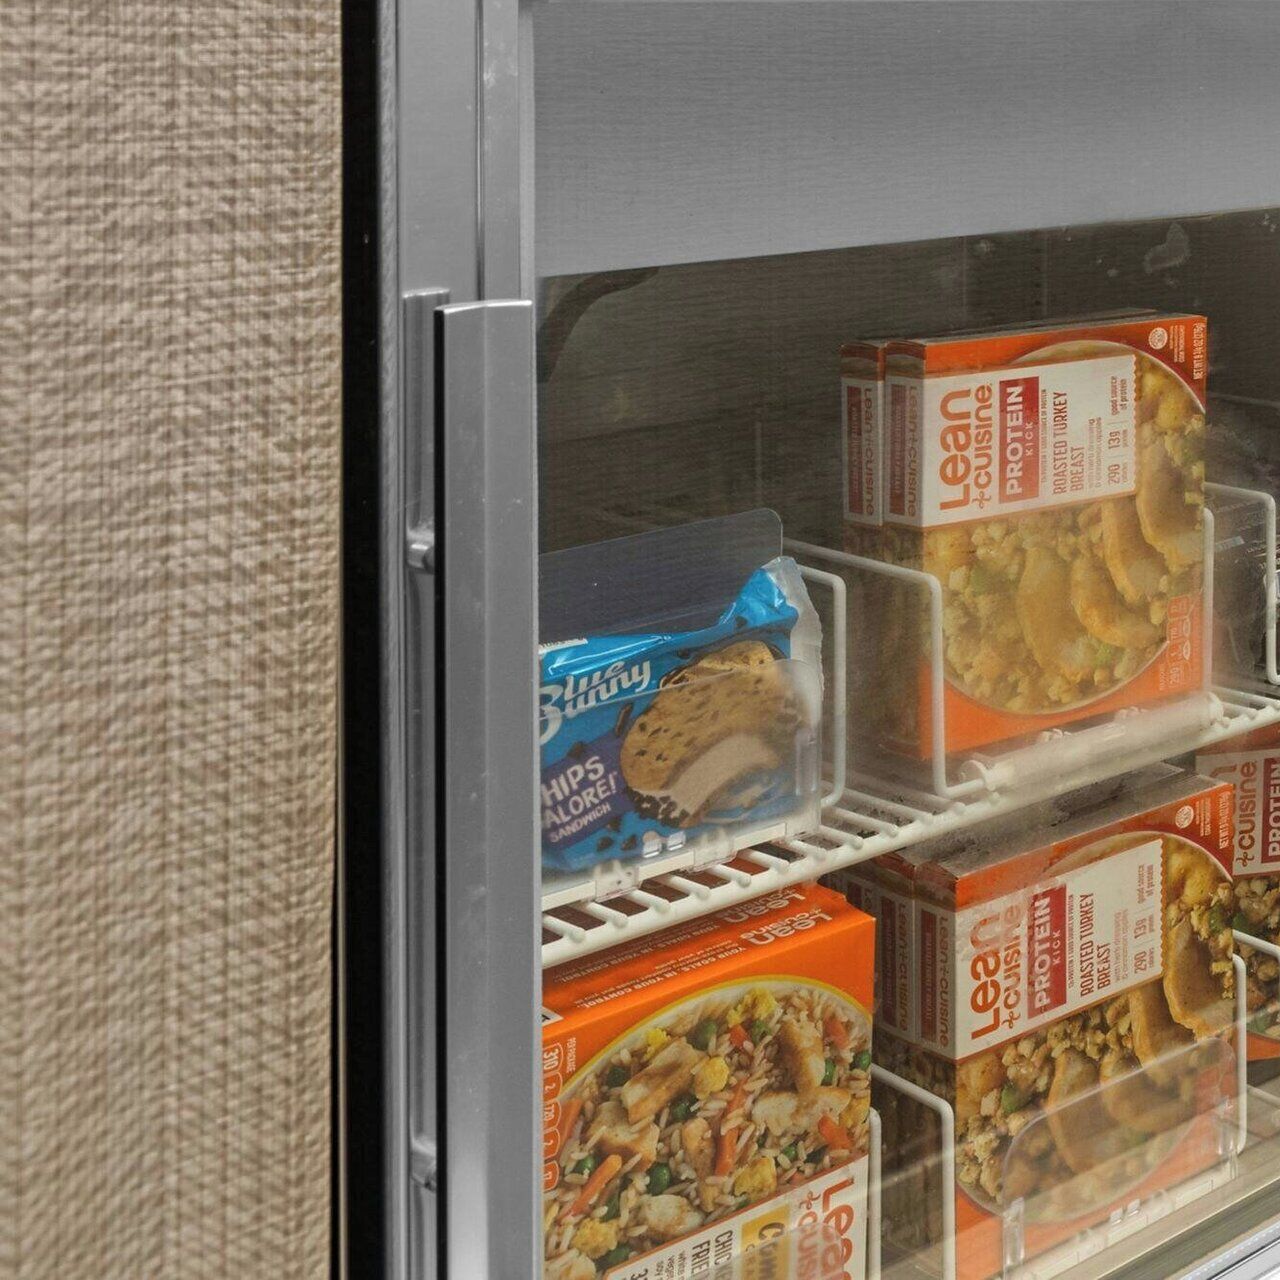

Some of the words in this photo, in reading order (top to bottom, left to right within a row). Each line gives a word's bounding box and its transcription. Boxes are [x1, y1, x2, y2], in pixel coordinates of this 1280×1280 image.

[973, 382, 993, 490] cuisine
[1054, 391, 1068, 438] TURKEY
[940, 388, 972, 511] Lean
[1006, 385, 1024, 496] PROTEIN
[1024, 420, 1034, 457] KICK
[1053, 441, 1067, 495] ROASTED
[1070, 445, 1085, 492] BREAST
[1107, 464, 1121, 487] 290
[550, 802, 612, 843] SANDWICH
[1238, 760, 1257, 850] cuisine
[751, 910, 833, 946] Lean
[1080, 893, 1094, 933] TURKEY
[718, 946, 747, 961] YOUR
[1034, 896, 1051, 1009] PROTEIN
[1052, 929, 1061, 966] KICK
[1080, 934, 1095, 998] ROASTED
[1097, 942, 1111, 990] BREAST
[1134, 951, 1147, 974] 290
[634, 975, 664, 990] YOUR
[970, 911, 1001, 1040] Lean
